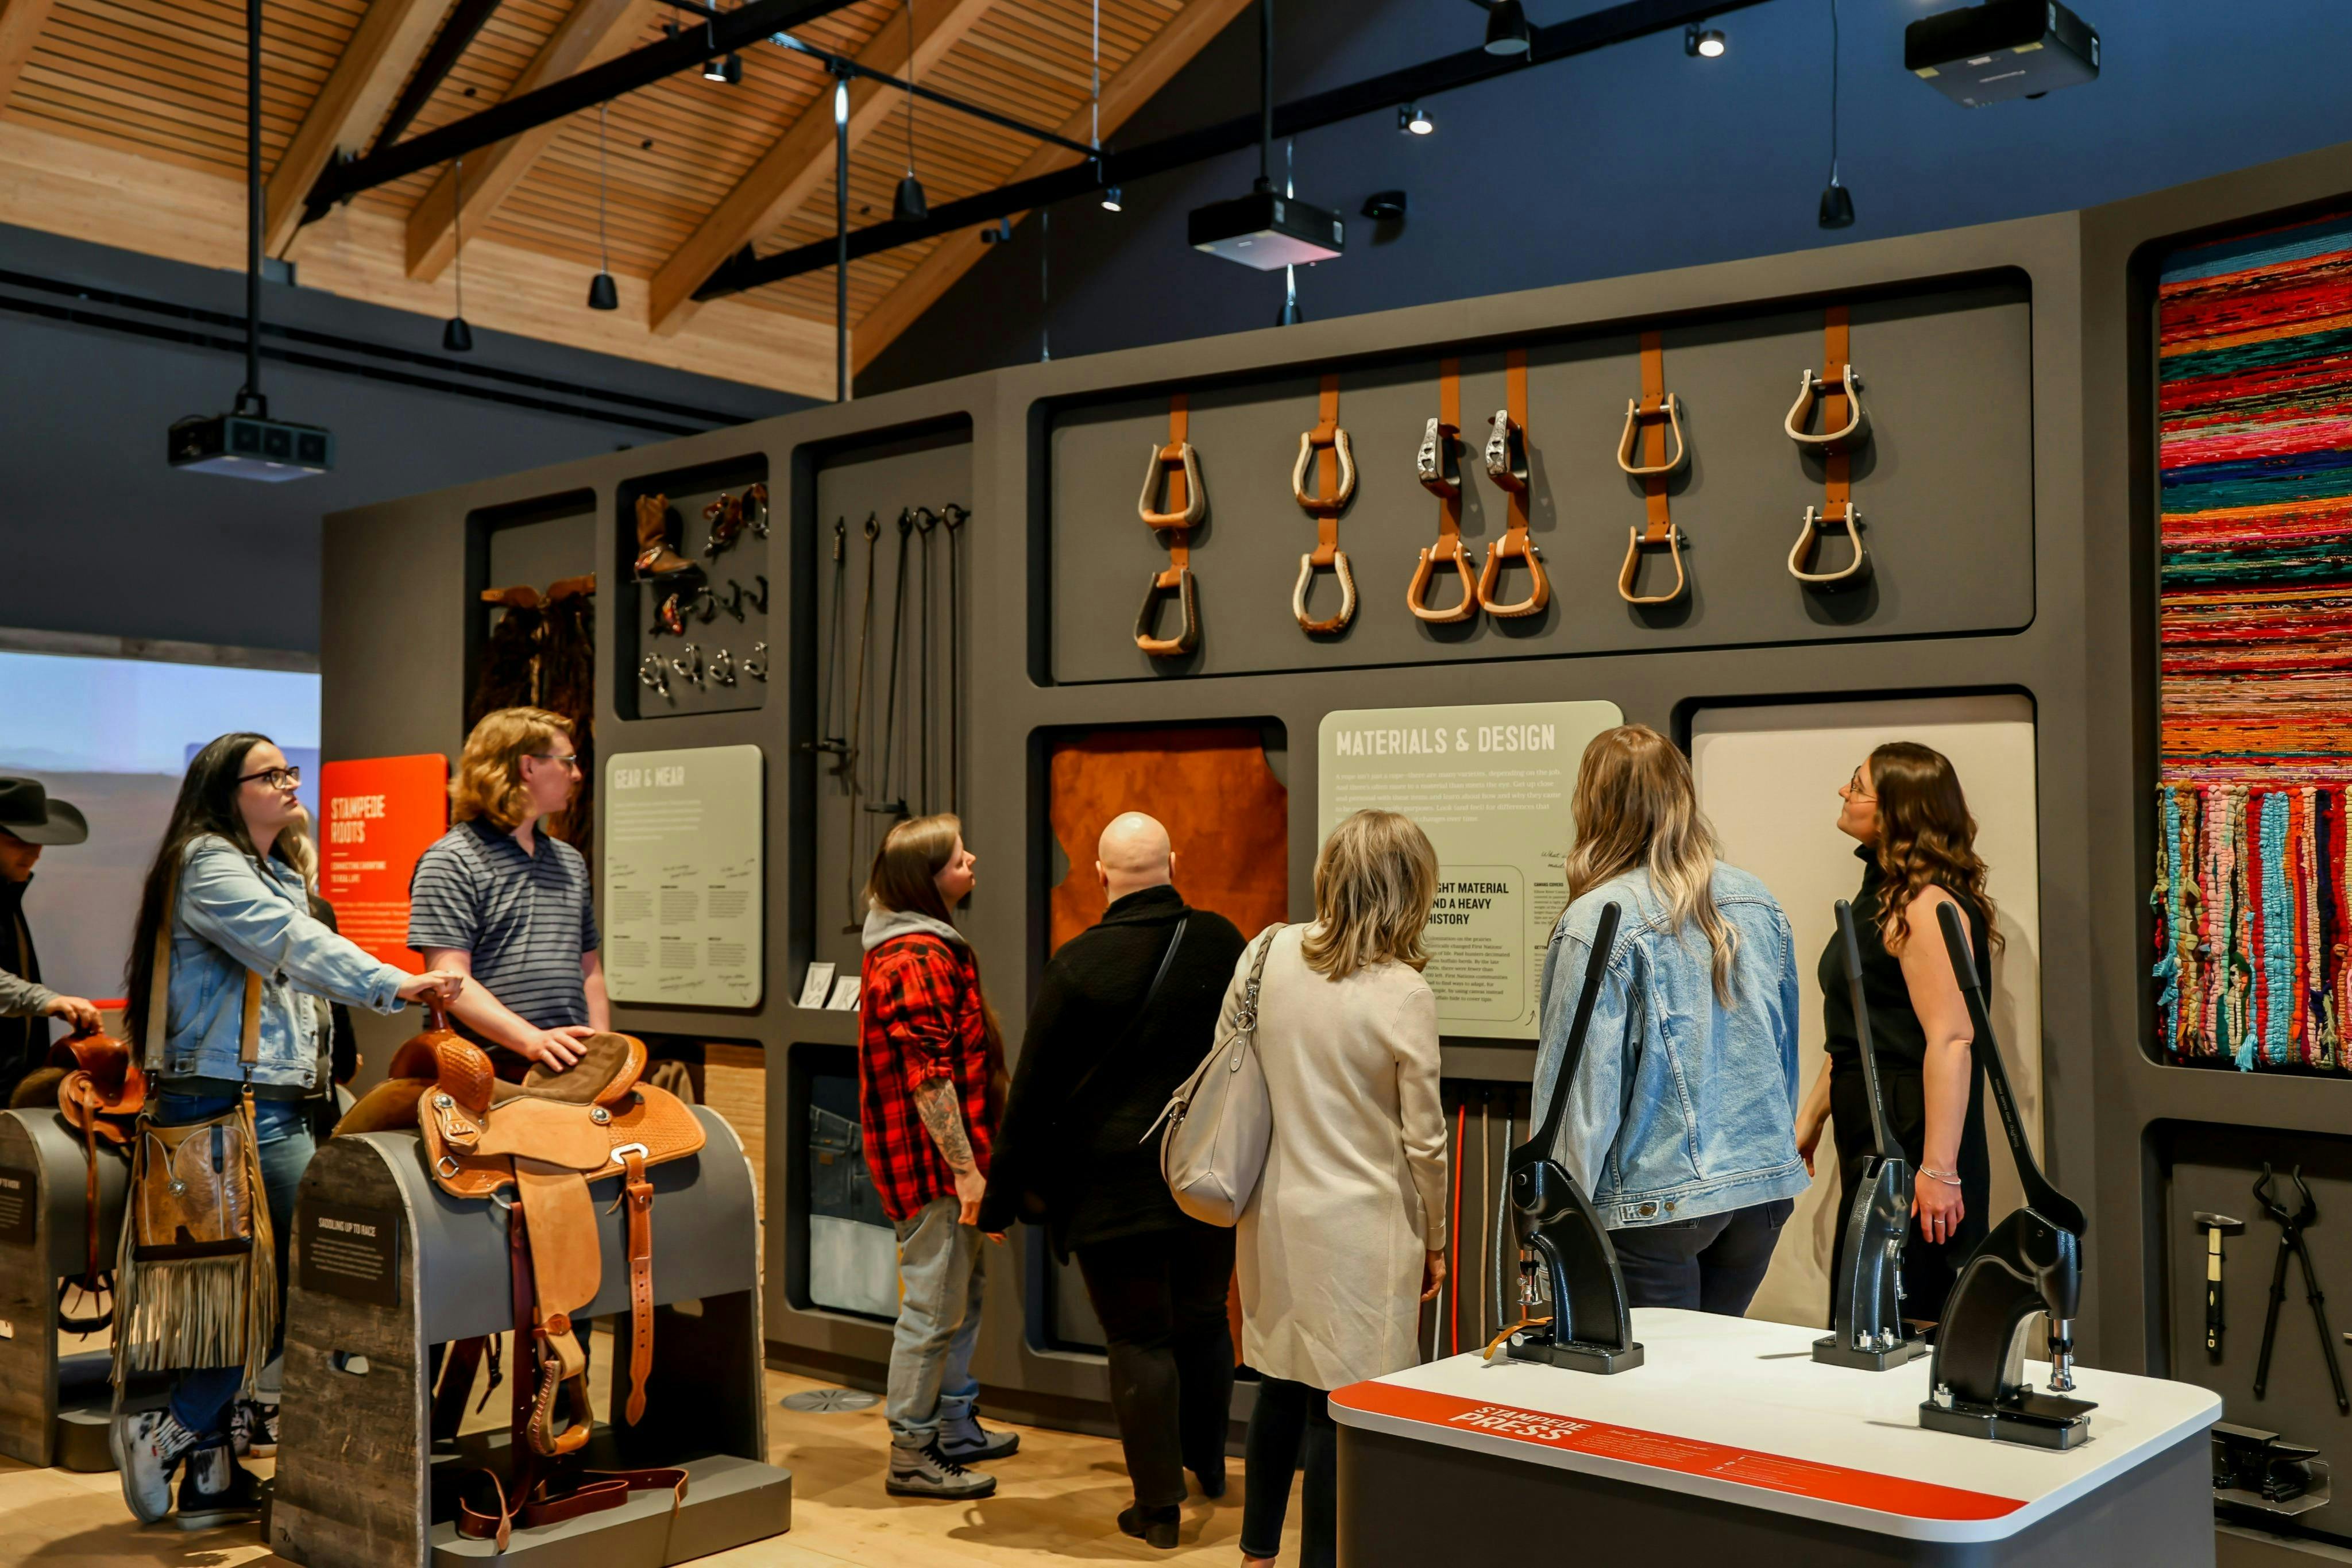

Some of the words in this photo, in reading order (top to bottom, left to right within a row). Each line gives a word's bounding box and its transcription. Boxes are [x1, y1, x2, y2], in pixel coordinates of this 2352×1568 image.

[1336, 728, 1448, 756] MATERIALS
[1455, 728, 1470, 752] &
[1478, 724, 1555, 752] DESIGN
[614, 768, 642, 790] GEAR
[1489, 770, 1525, 778] depending
[1548, 768, 1562, 777] job.
[1511, 792, 1526, 800] why
[1527, 791, 1542, 800] they
[331, 794, 386, 820] STAMPEDE
[1497, 802, 1535, 810] differences
[330, 820, 366, 844] ROOTS
[1437, 883, 1455, 893] GHT
[1458, 883, 1509, 894] MATERIAL
[1432, 898, 1447, 909] ND
[1449, 898, 1455, 909] A
[1458, 898, 1492, 909] HEAVY
[318, 1217, 345, 1231] SADDLING
[345, 1222, 353, 1233] UP
[353, 1223, 360, 1235] TO
[1447, 1411, 1574, 1440] PRESS
[1474, 1406, 1593, 1432] STAMPEDE
